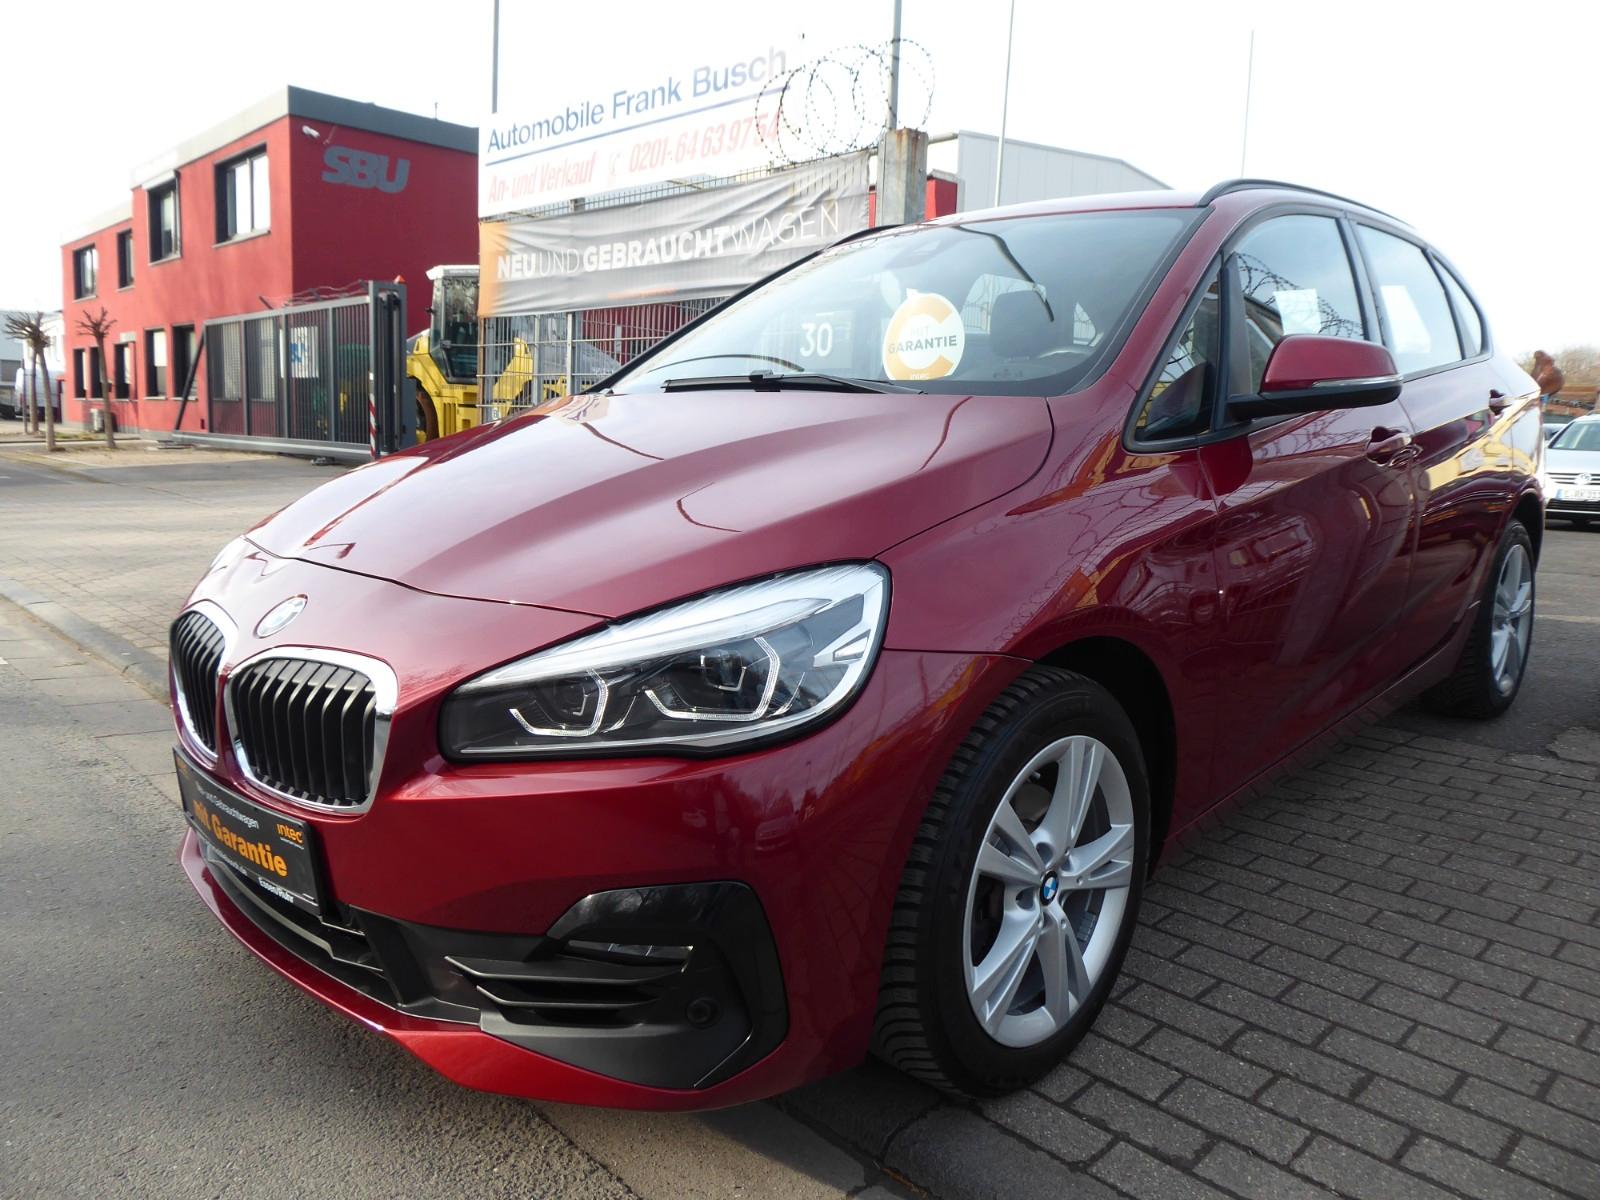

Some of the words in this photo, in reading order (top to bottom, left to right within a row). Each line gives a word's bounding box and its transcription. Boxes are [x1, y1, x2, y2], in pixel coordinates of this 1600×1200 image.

[487, 100, 605, 153] Automobile
[612, 76, 682, 119] Frank
[692, 45, 788, 98] Busch
[321, 145, 411, 193] SBU
[538, 152, 599, 193] Verkauf
[800, 322, 832, 357] 30
[888, 335, 958, 354] GARANTIE
[210, 814, 288, 877] Garantie
